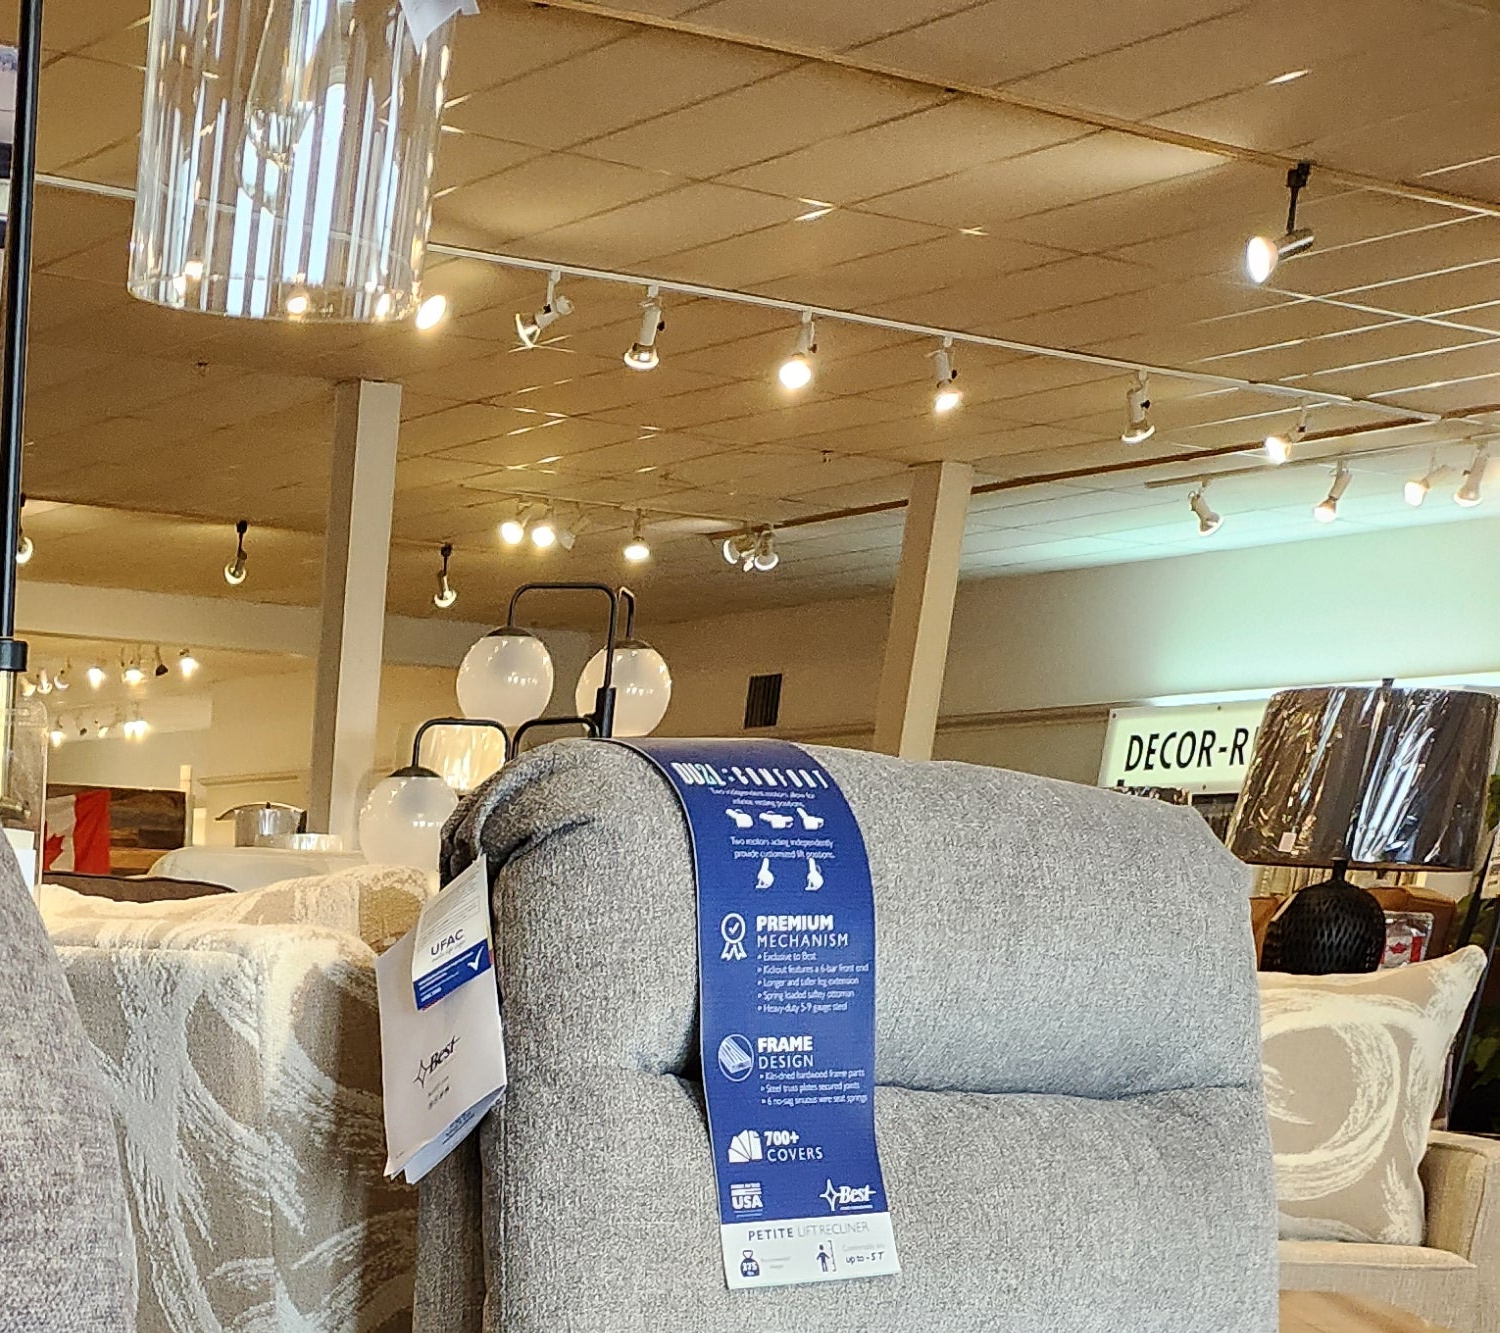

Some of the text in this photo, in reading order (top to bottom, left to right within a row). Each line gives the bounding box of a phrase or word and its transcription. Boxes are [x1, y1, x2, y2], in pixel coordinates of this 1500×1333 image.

[1124, 727, 1261, 772] DECOR-R
[756, 914, 834, 932] PREMIUM
[430, 928, 464, 956] UFAC
[756, 932, 849, 948] MECHANISM
[793, 952, 800, 961] to
[855, 963, 870, 972] end
[763, 978, 785, 989] Longer
[787, 978, 800, 987] and
[763, 991, 784, 1001] Spring
[757, 1035, 813, 1053] FRAME
[758, 1054, 814, 1069] DESIGN
[764, 1130, 800, 1146] 700+
[766, 1146, 823, 1162] COVERS
[838, 1184, 876, 1204] Best
[731, 1195, 763, 1210] USA
[748, 1221, 871, 1241] PETITE LIFT RECLINER
